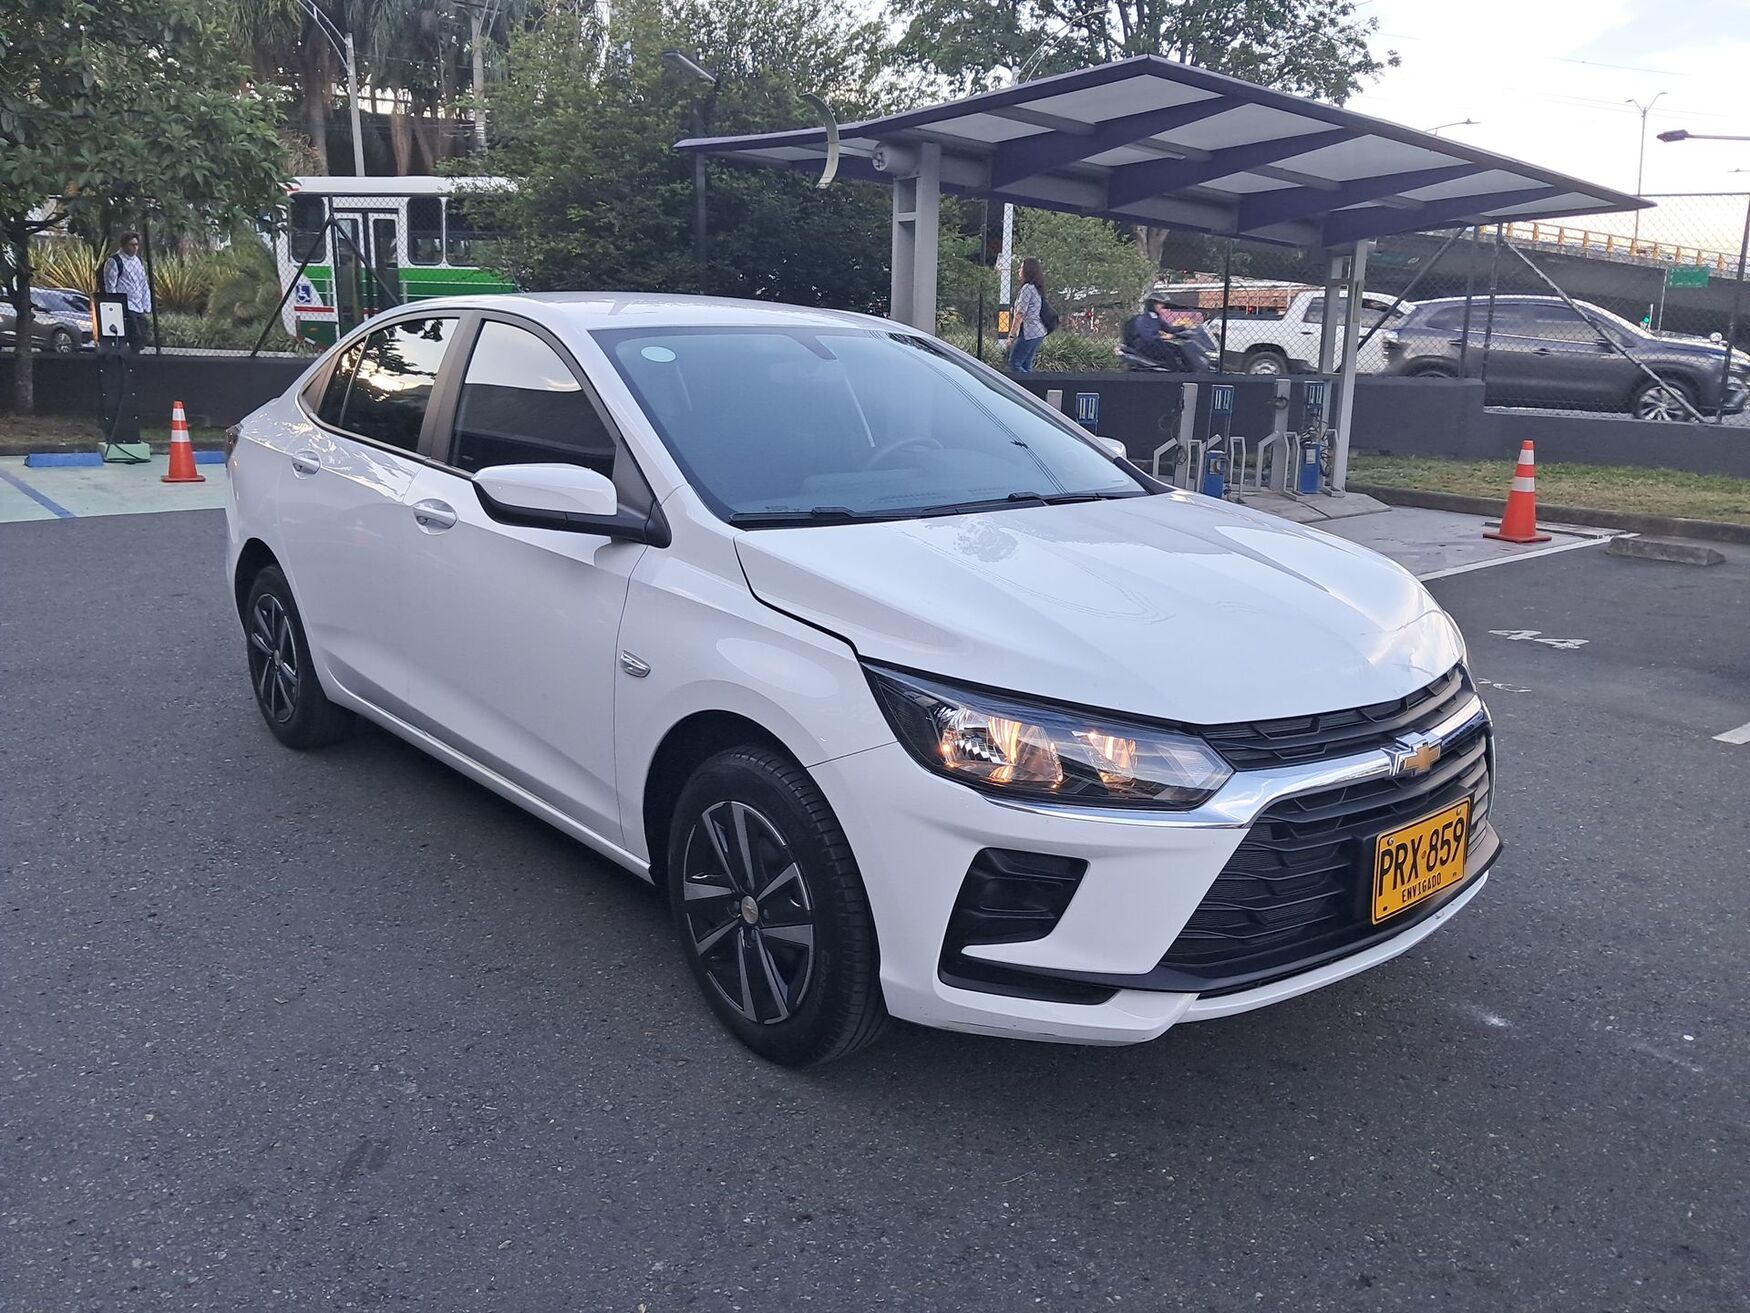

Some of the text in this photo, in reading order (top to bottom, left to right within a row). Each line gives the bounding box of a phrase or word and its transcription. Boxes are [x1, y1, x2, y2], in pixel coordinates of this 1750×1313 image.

[1378, 817, 1465, 897] PRX 859
[1402, 872, 1442, 903] ENVIGADO
